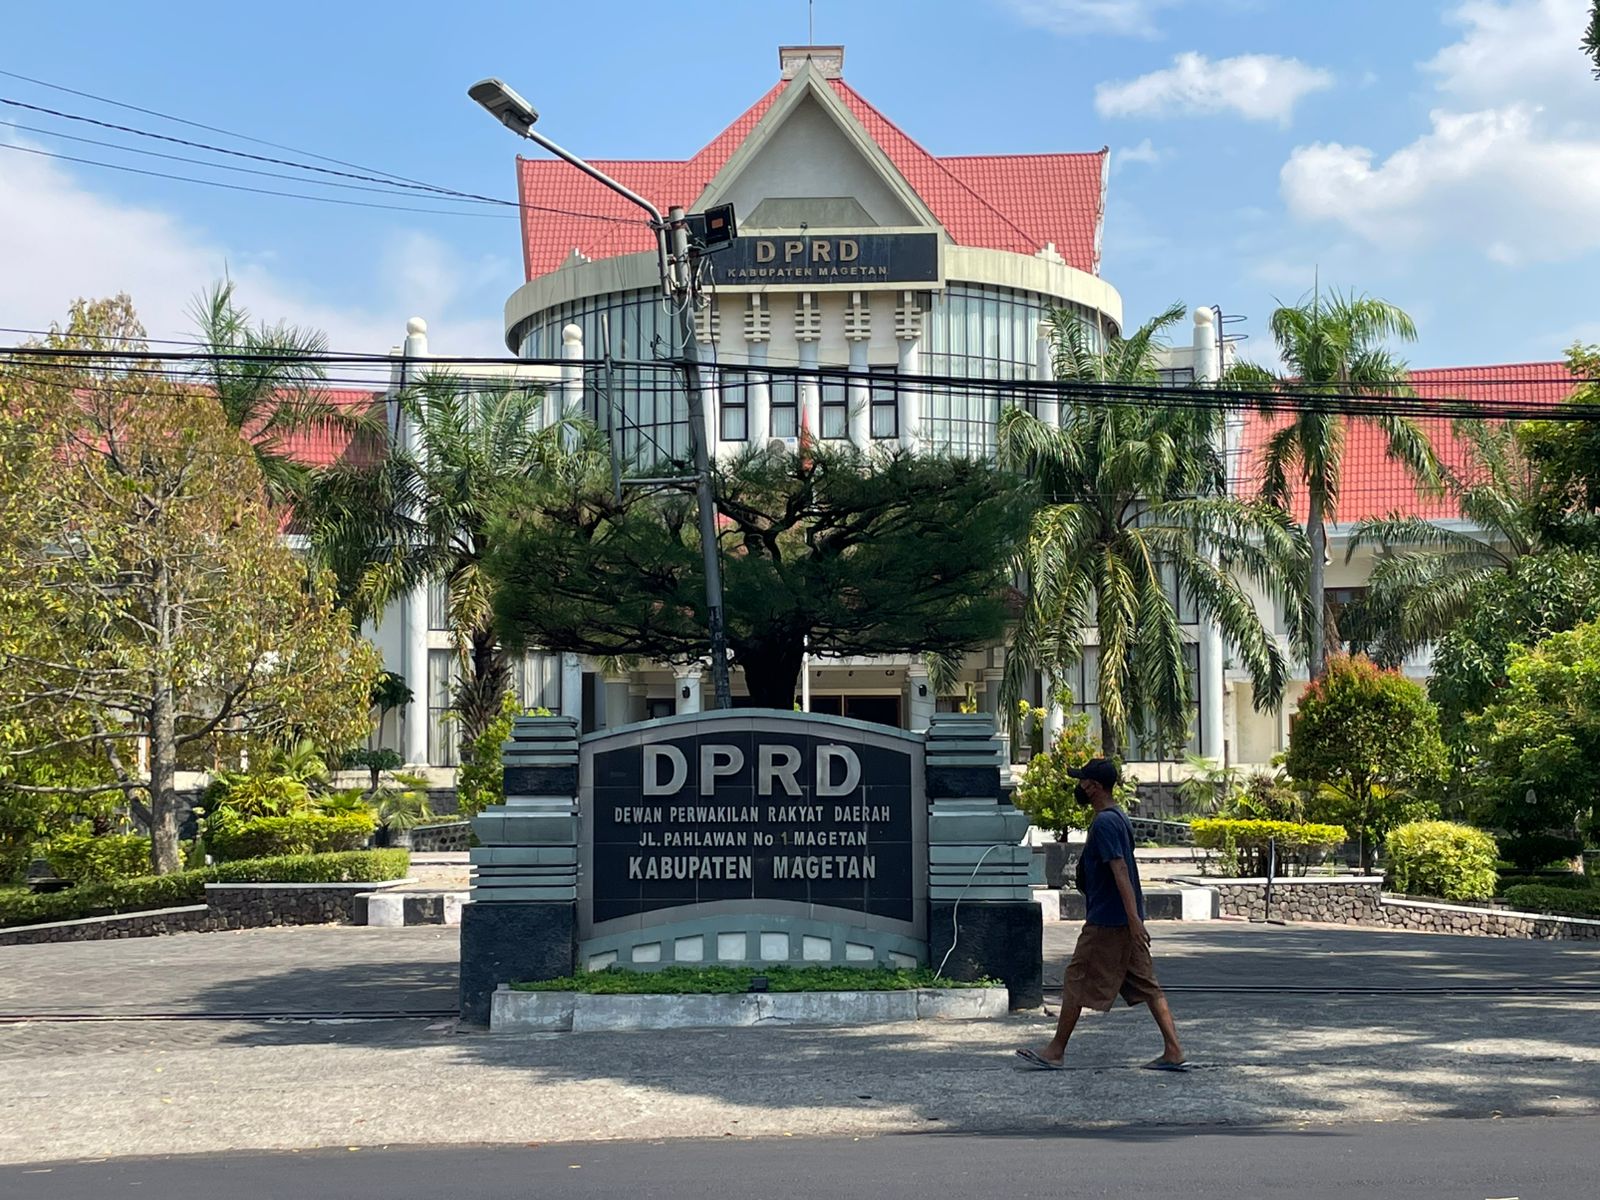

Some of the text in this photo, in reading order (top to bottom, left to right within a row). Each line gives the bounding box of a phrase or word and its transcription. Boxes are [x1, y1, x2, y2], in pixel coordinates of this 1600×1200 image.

[756, 240, 860, 263] DPRD
[728, 266, 887, 277] KABUPATEN MAGETAN
[643, 743, 862, 797] DPRD
[614, 805, 891, 824] DEWAN PERWAKILAN RAKYAT DAERAH
[752, 831, 775, 847] No
[779, 831, 790, 847] 1
[793, 830, 868, 847] MAGETAN
[628, 854, 877, 881] KABUPATEN MAGETAN
